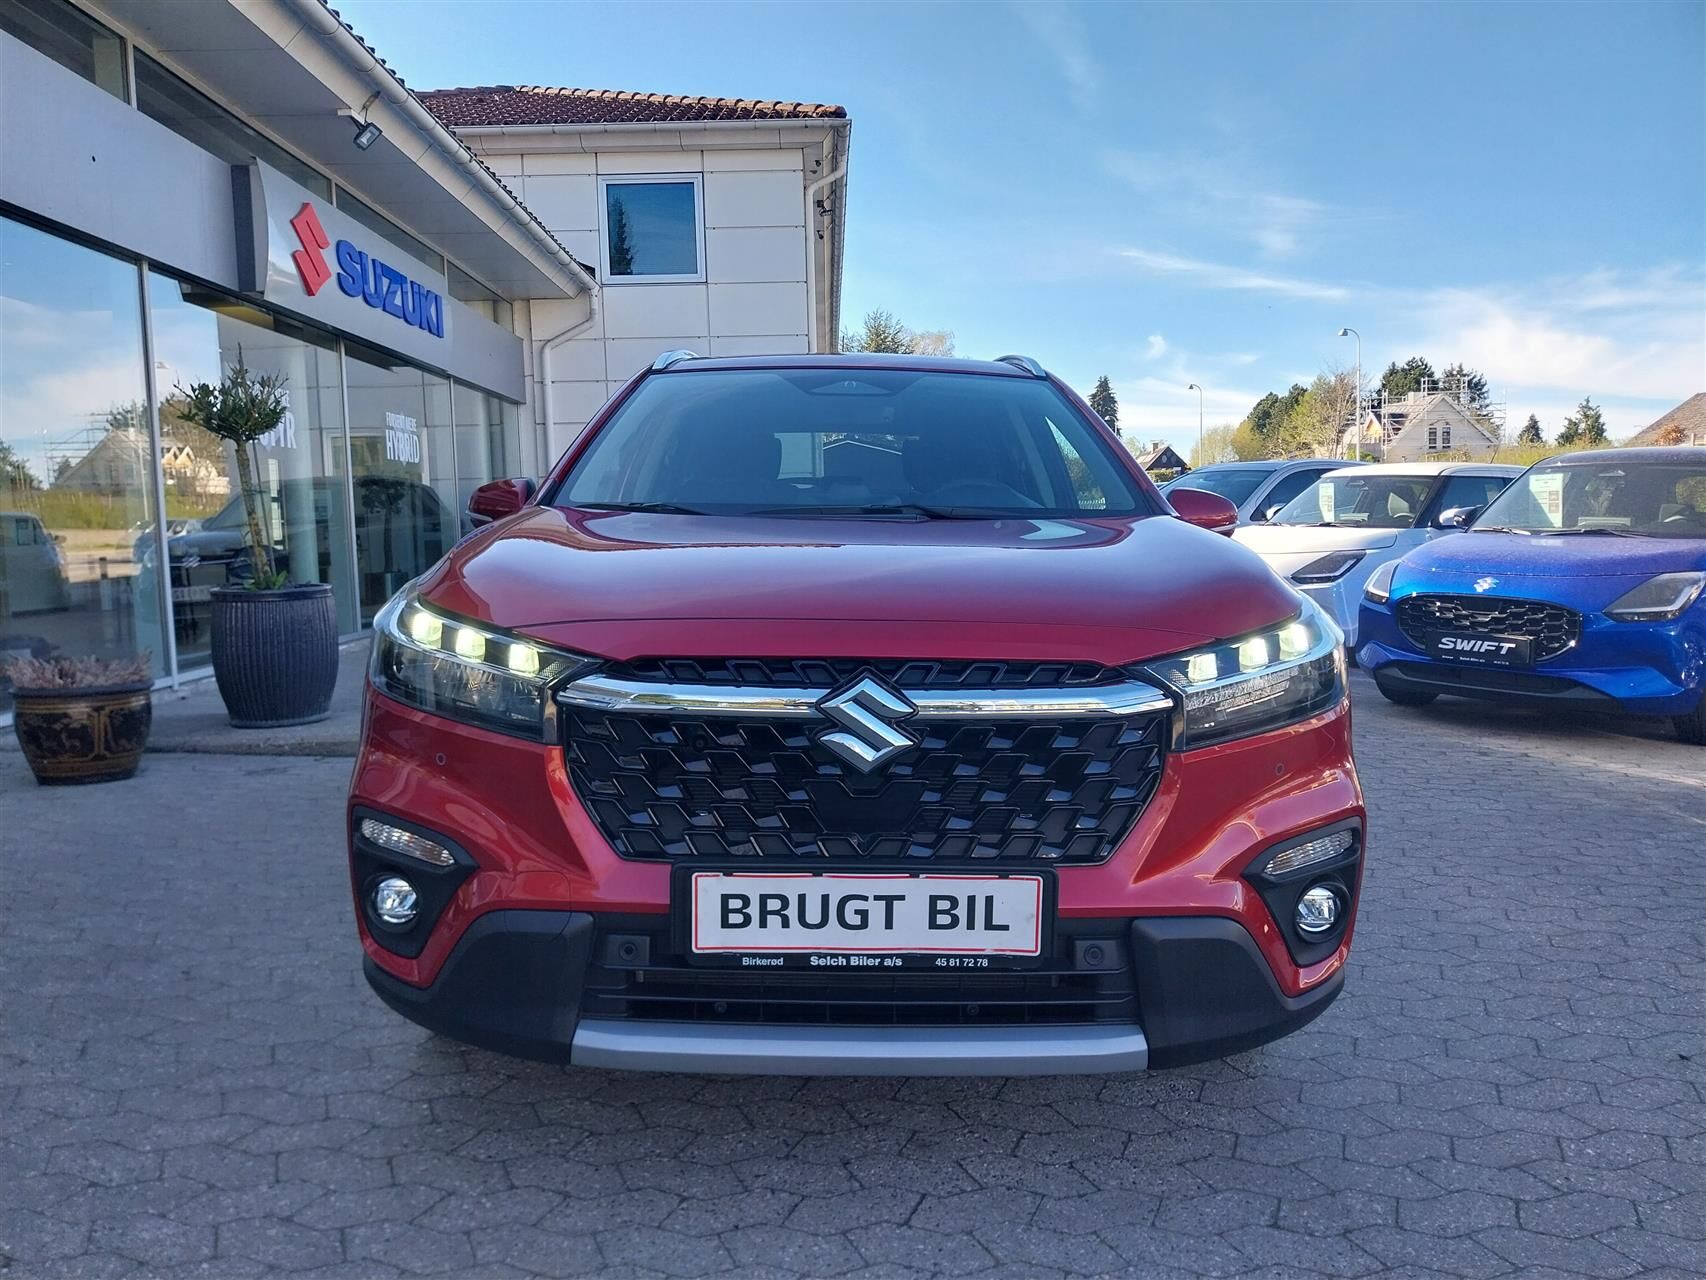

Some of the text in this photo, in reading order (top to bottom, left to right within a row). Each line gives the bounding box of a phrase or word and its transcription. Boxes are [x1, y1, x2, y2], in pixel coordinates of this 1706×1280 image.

[335, 239, 445, 339] SUZUKI
[385, 429, 420, 464] HYBRID
[1438, 637, 1517, 655] SWIFT
[720, 893, 1010, 932] BRUGT BIL
[742, 956, 784, 967] Birkerød
[809, 955, 903, 968] Selch Biler a/s
